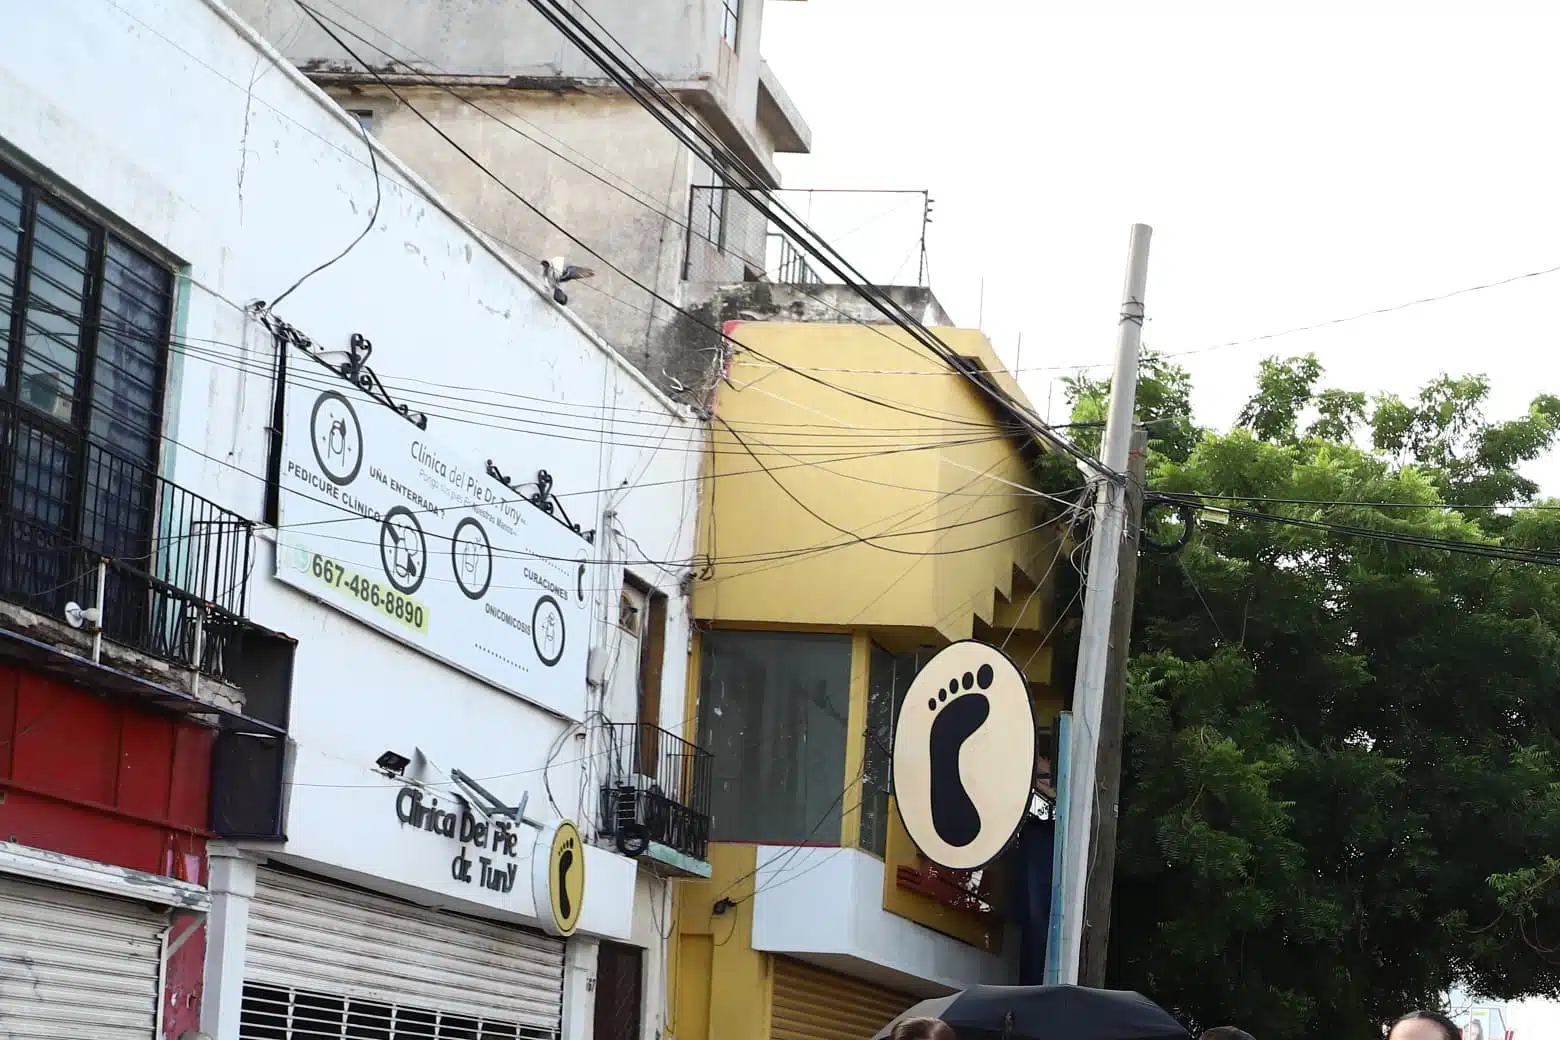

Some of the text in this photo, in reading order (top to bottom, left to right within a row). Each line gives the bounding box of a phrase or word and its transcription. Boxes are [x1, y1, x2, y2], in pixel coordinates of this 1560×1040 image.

[288, 460, 339, 500] PEDICURE
[369, 465, 389, 486] UÑA
[390, 479, 440, 516] ENTERRADA
[449, 465, 465, 488] del
[467, 476, 483, 500] Pie
[485, 487, 498, 509] Dr.
[500, 497, 521, 526] Tuny
[312, 553, 423, 628] 667-486-8890
[523, 567, 569, 601] CURACIONES
[485, 602, 532, 636] ONICOMICOSIS
[459, 809, 488, 848] Del
[492, 818, 518, 858] Pie
